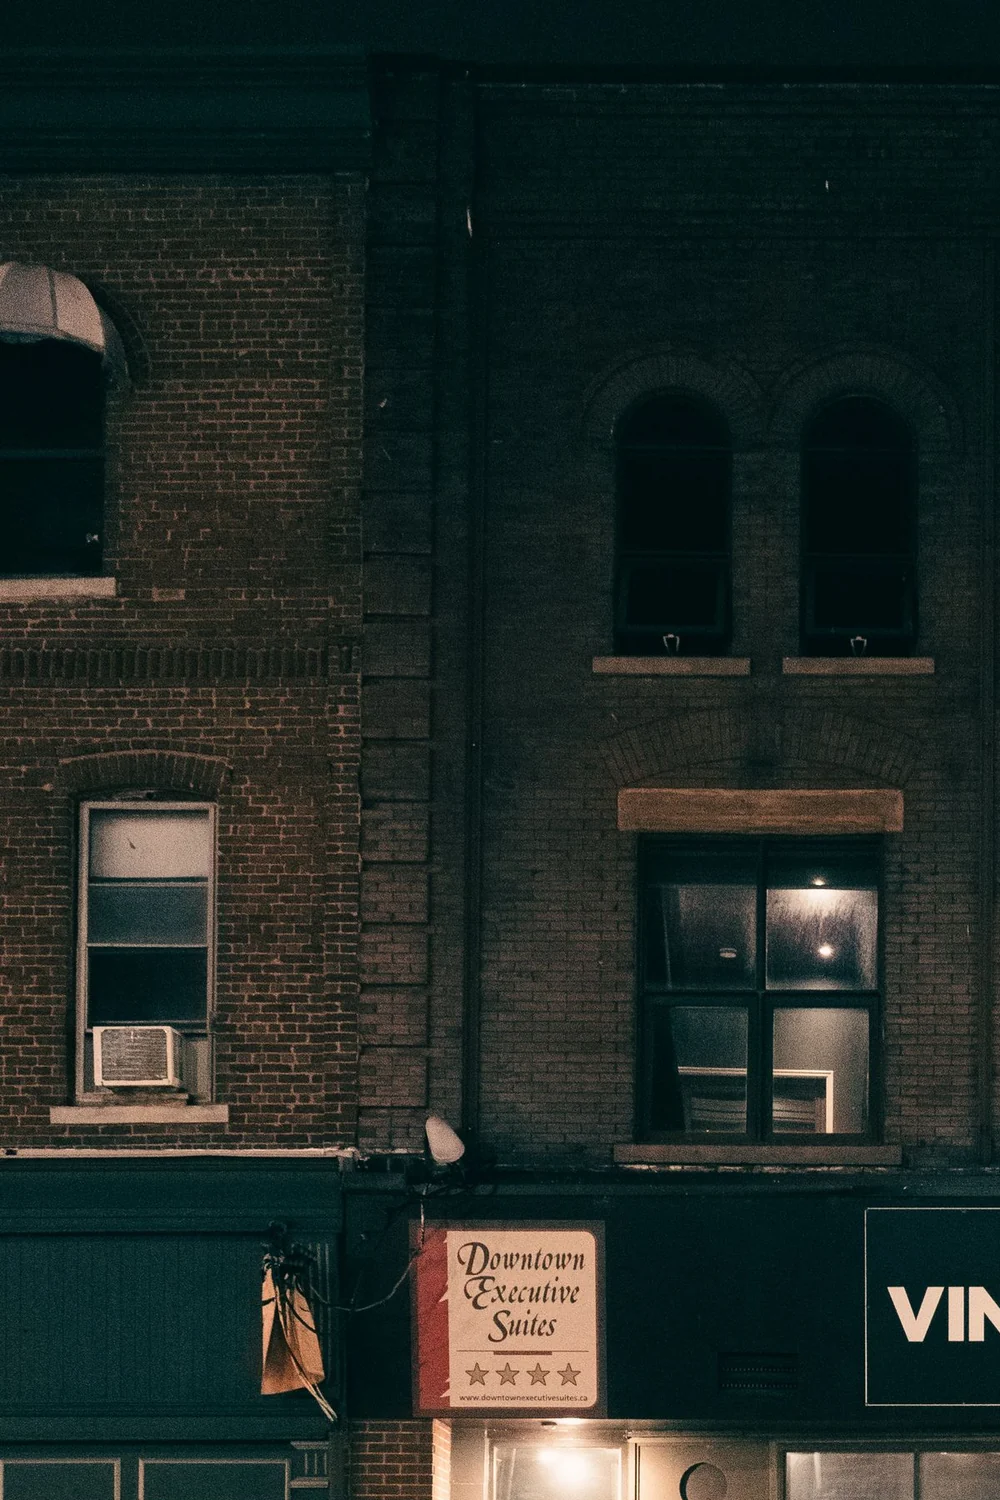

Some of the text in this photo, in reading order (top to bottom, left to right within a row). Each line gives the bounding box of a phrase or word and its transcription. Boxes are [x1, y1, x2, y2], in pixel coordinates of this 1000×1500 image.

[457, 1241, 586, 1276] Downtown
[463, 1276, 580, 1310] Executive
[487, 1309, 557, 1343] Suites
[459, 1394, 588, 1402] www.downtownexecutivesuites.ca
